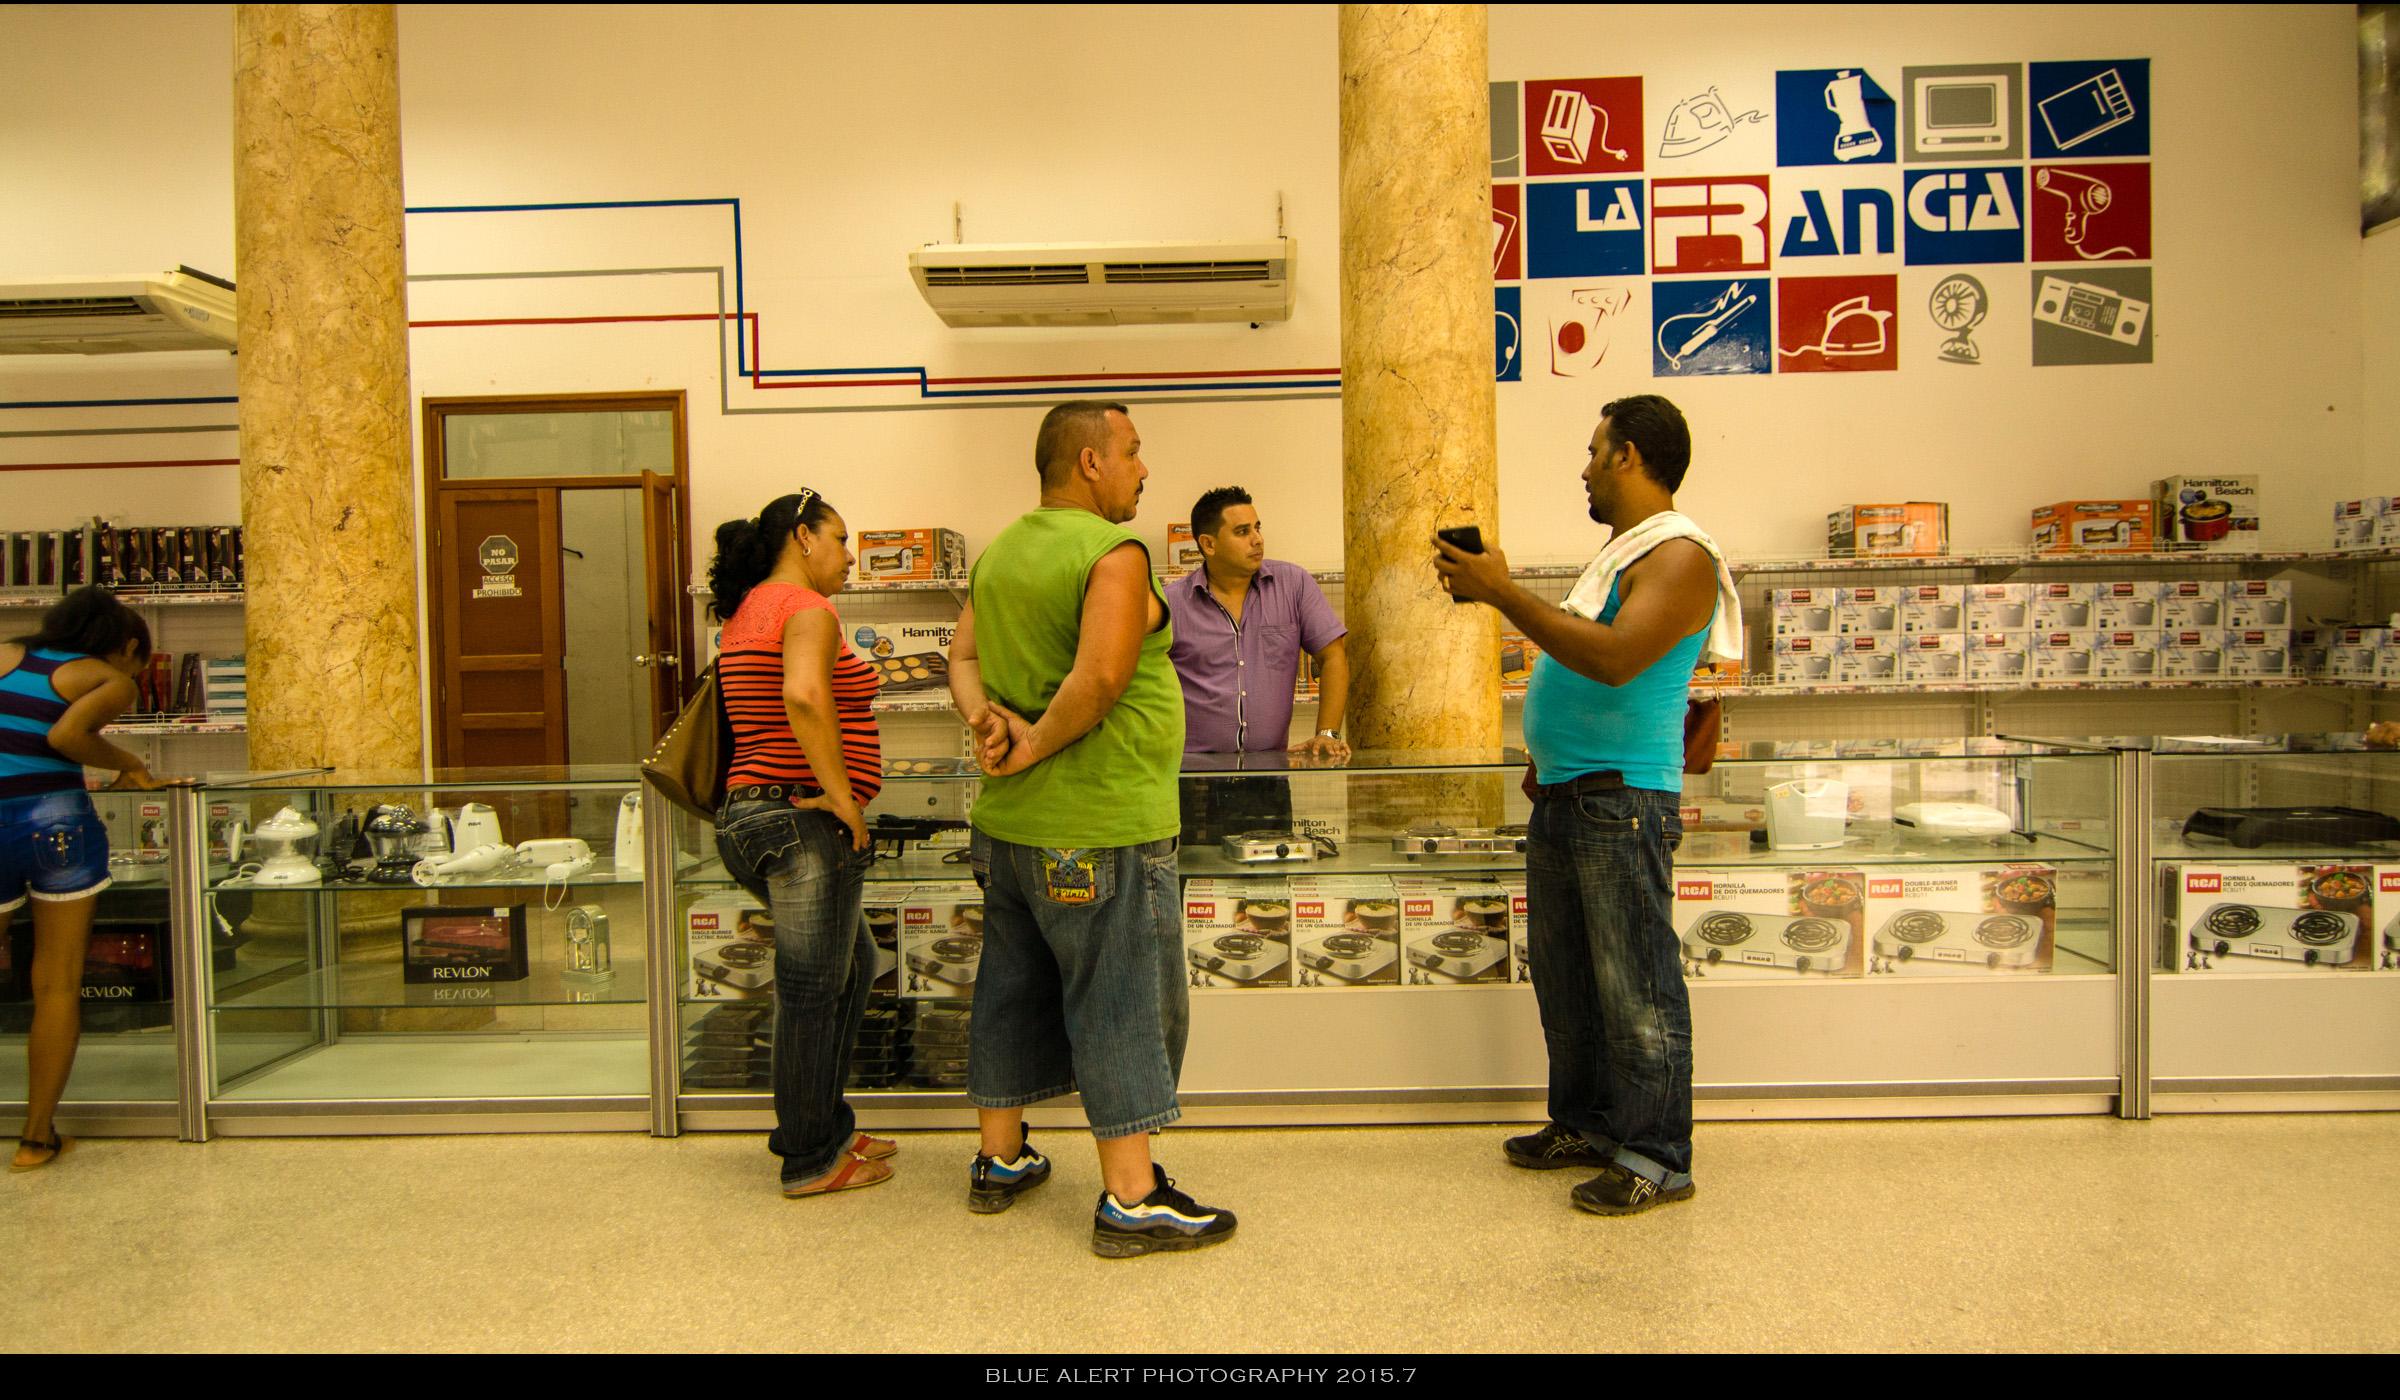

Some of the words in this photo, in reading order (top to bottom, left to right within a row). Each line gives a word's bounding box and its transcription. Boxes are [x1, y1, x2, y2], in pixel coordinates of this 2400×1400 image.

[1576, 187, 1641, 231] LA
[2183, 479, 2239, 488] Hamilton
[2215, 486, 2254, 495] Beach
[477, 587, 521, 595] PROHIBIDO
[902, 627, 957, 637] Hamilto
[1292, 818, 1326, 827] milton
[1304, 826, 1340, 835] Beach
[2189, 878, 2218, 888] RCA
[2382, 877, 2400, 887] RC
[1680, 886, 1709, 896] RCA
[1871, 884, 1900, 894] RCA
[1188, 906, 1213, 915] RCA
[1298, 906, 1321, 914] RCA
[1406, 904, 1431, 912] RCA
[906, 912, 930, 920] RCA
[693, 918, 717, 926] RCA
[433, 967, 490, 979] REVLON
[81, 986, 132, 998] REVLON
